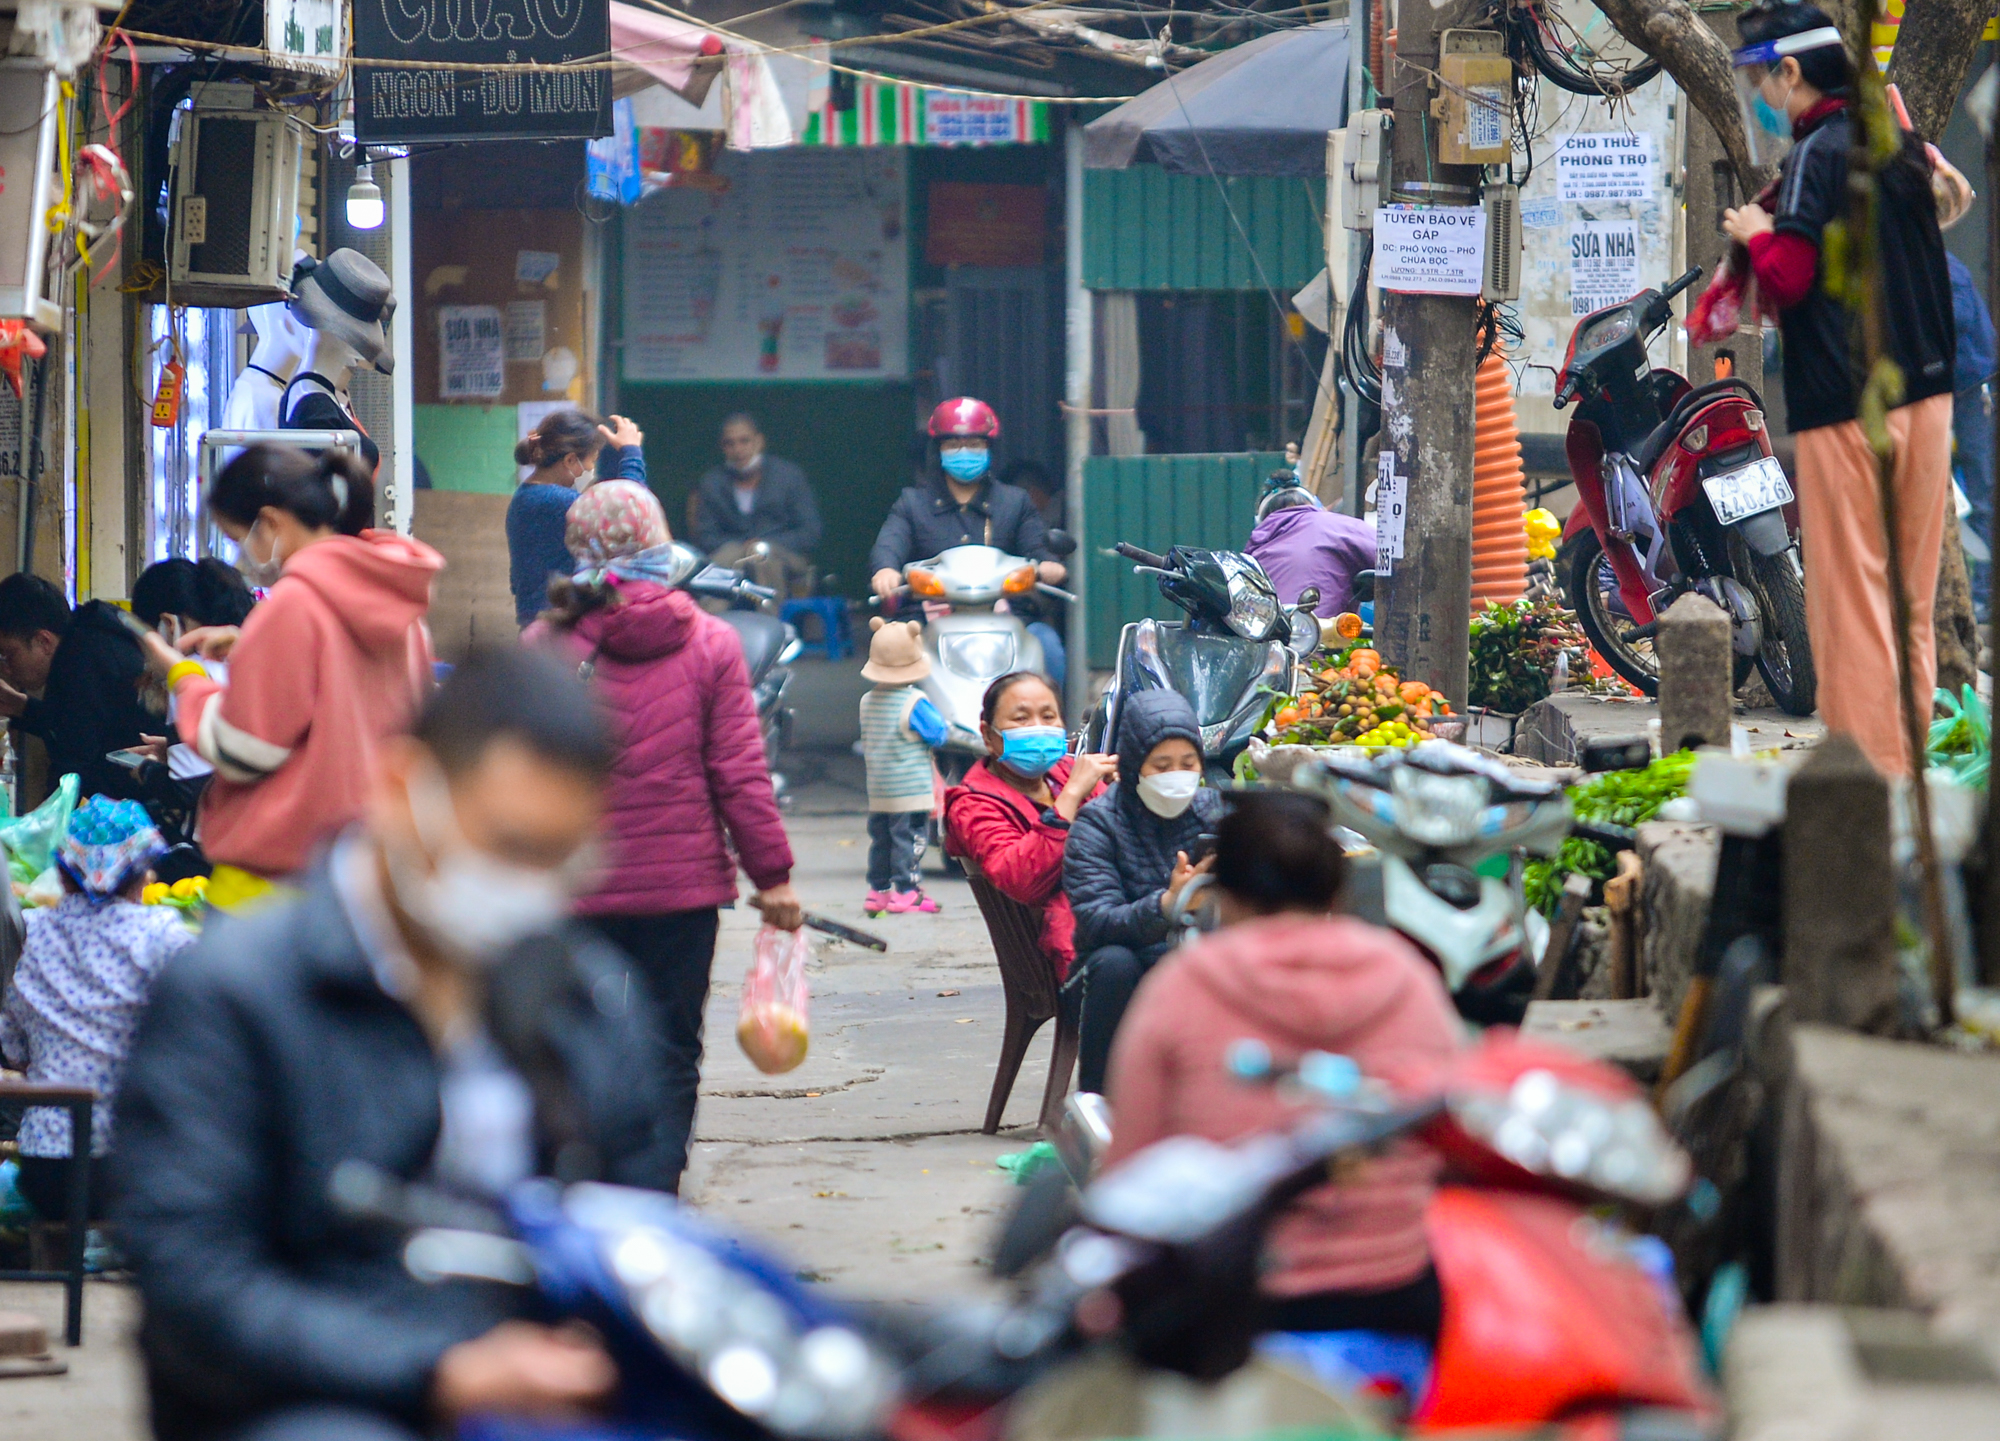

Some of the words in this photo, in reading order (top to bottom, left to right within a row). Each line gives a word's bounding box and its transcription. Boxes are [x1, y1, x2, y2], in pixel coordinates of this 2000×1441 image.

[1566, 138, 1597, 149] CHO
[1560, 153, 1613, 166] PHÒNG
[1618, 154, 1647, 167] TRỌ
[1571, 222, 1601, 258] SỬA
[1605, 227, 1636, 257] NHÀ
[1421, 246, 1447, 255] VỌNG
[1572, 296, 1595, 314] 0981
